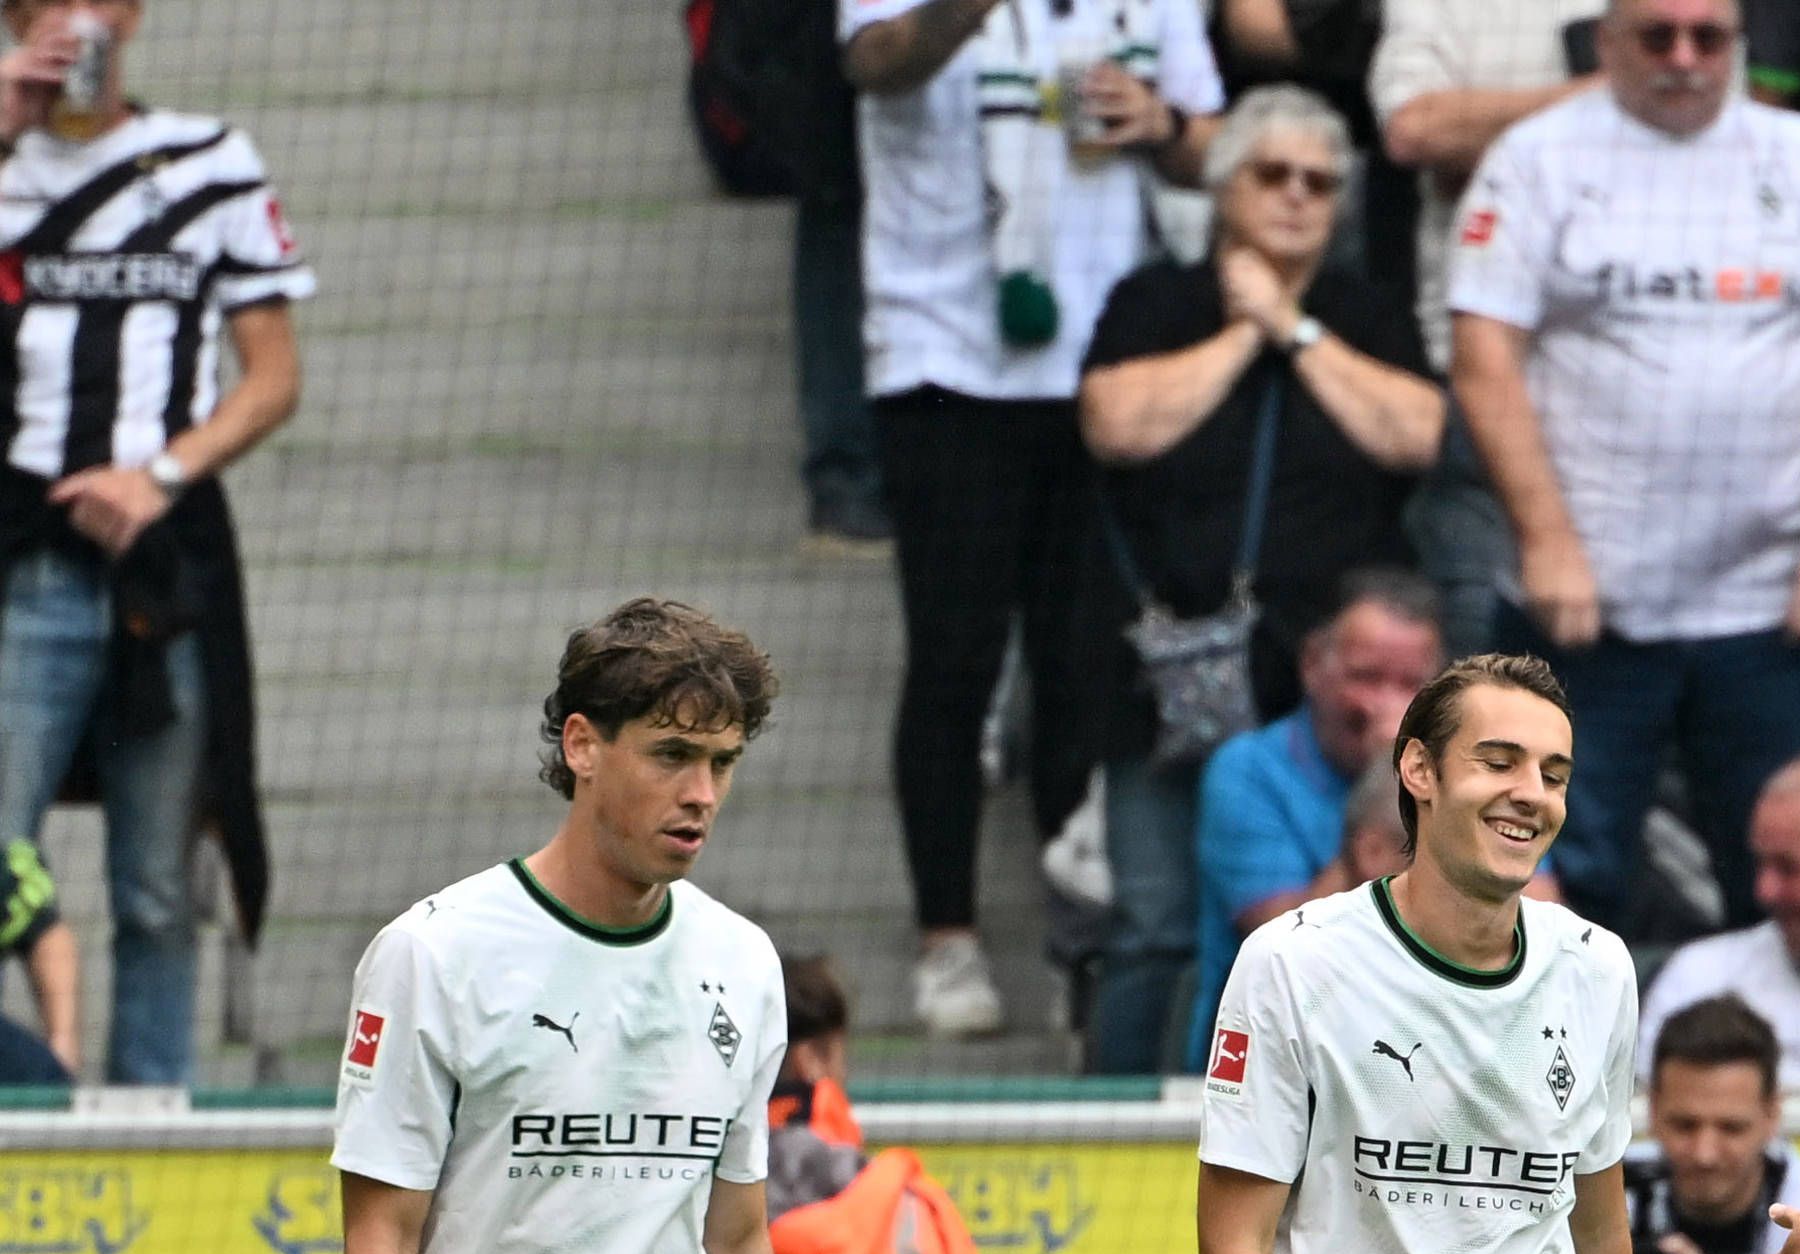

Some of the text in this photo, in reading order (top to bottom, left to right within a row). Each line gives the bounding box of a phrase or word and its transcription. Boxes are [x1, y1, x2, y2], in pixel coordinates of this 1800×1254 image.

[1207, 1083, 1241, 1096] DESLIGA
[512, 1113, 736, 1148] REUTE
[0, 1168, 132, 1246] BH
